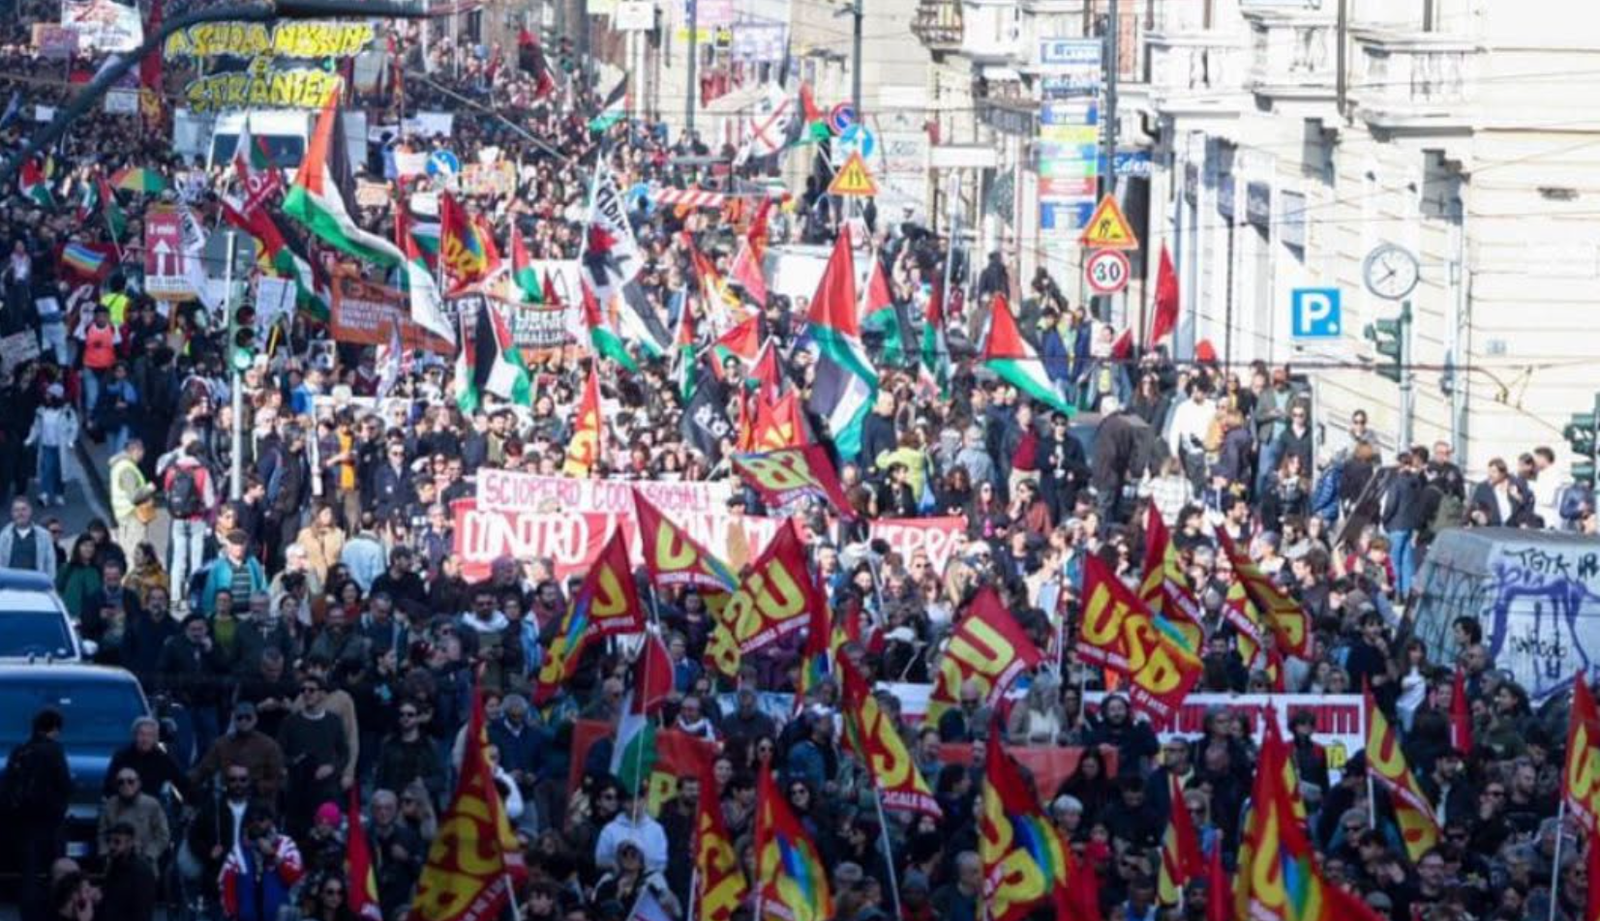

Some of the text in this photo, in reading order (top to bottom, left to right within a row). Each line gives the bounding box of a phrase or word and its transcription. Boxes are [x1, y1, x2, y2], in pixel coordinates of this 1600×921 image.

[1113, 156, 1152, 173] Eden
[1092, 262, 1122, 282] 30
[485, 473, 582, 508] SCIOPERO
[592, 483, 636, 511] COO
[463, 510, 590, 564] CONTRO
[1082, 582, 1181, 694] USB
